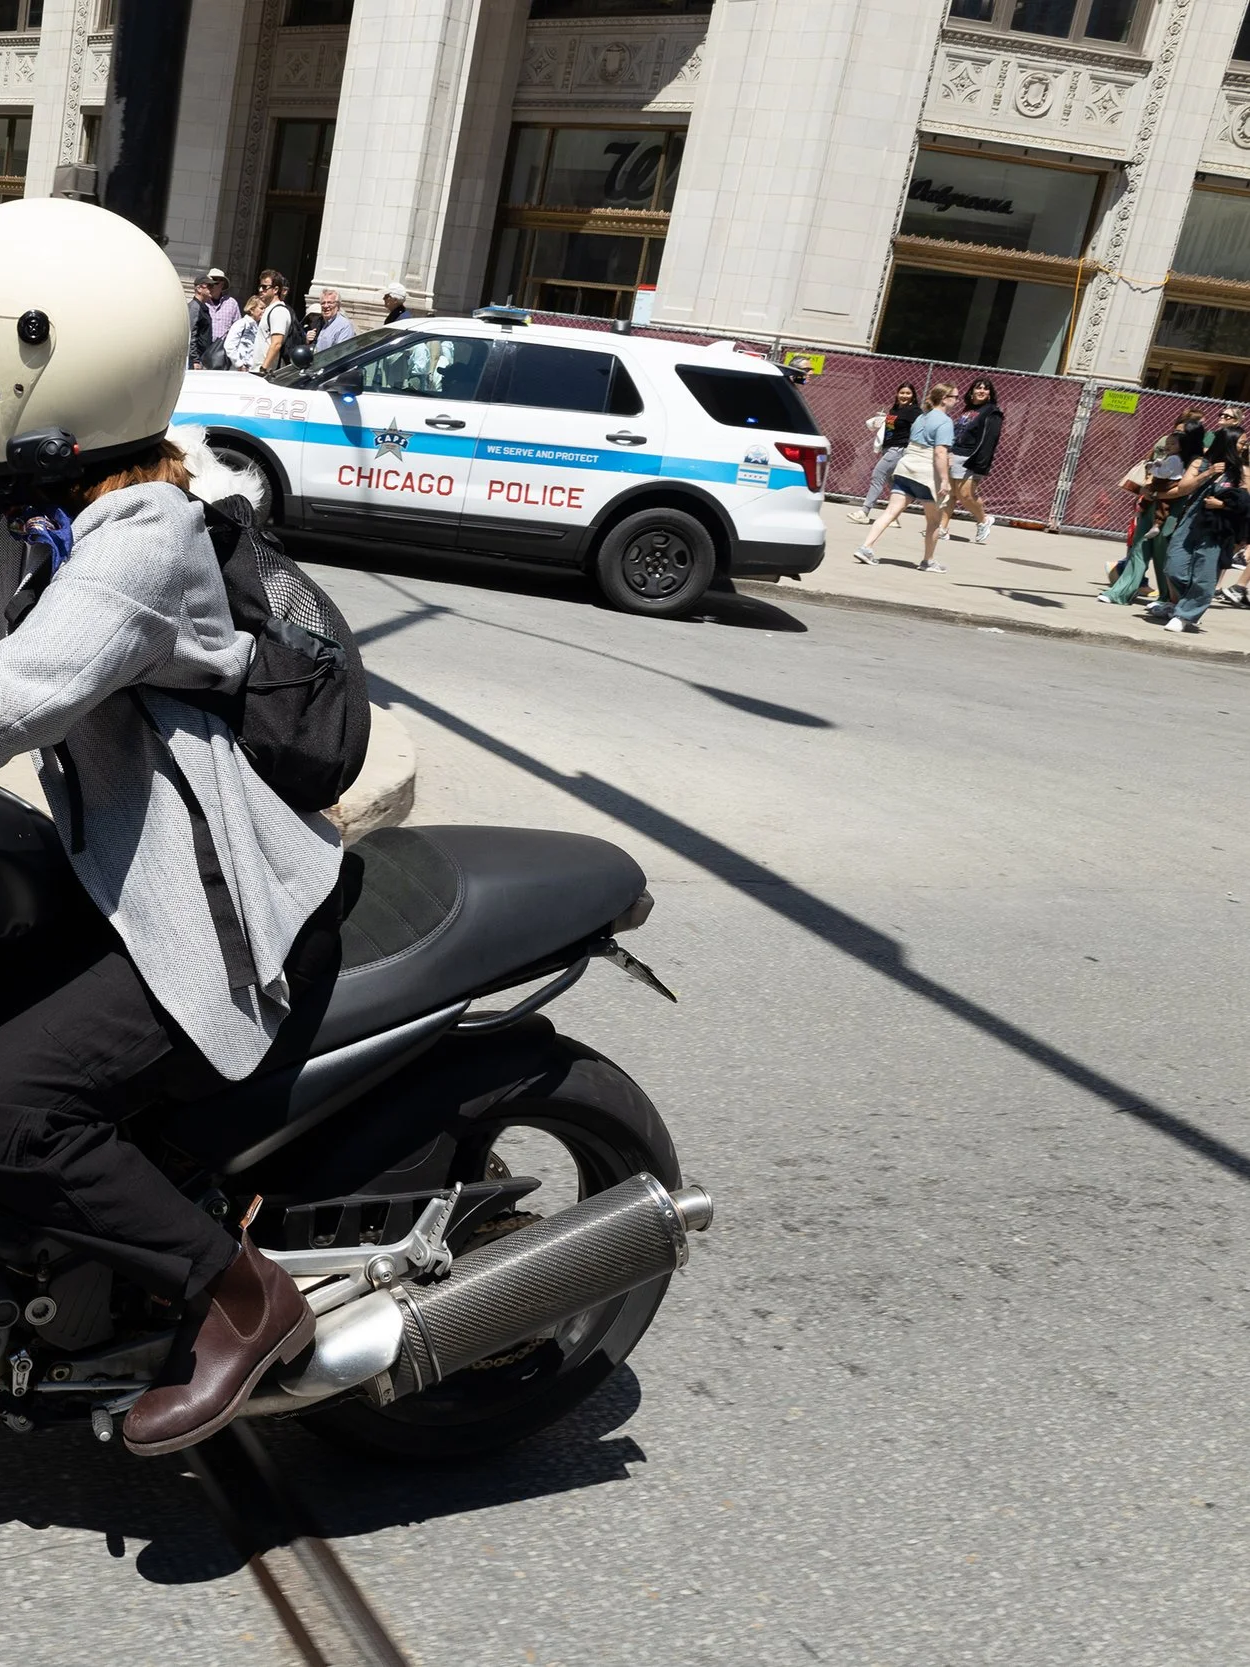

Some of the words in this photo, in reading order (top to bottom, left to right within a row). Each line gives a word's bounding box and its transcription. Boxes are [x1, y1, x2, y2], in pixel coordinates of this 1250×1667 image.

[238, 396, 308, 421] 7242
[377, 434, 406, 446] CAPS
[487, 445, 502, 455] WE
[502, 446, 534, 458] SERVE
[535, 449, 555, 459] AND
[555, 452, 599, 463] PROTECT
[337, 465, 454, 496] CHICAGO
[487, 480, 585, 509] POLICE
